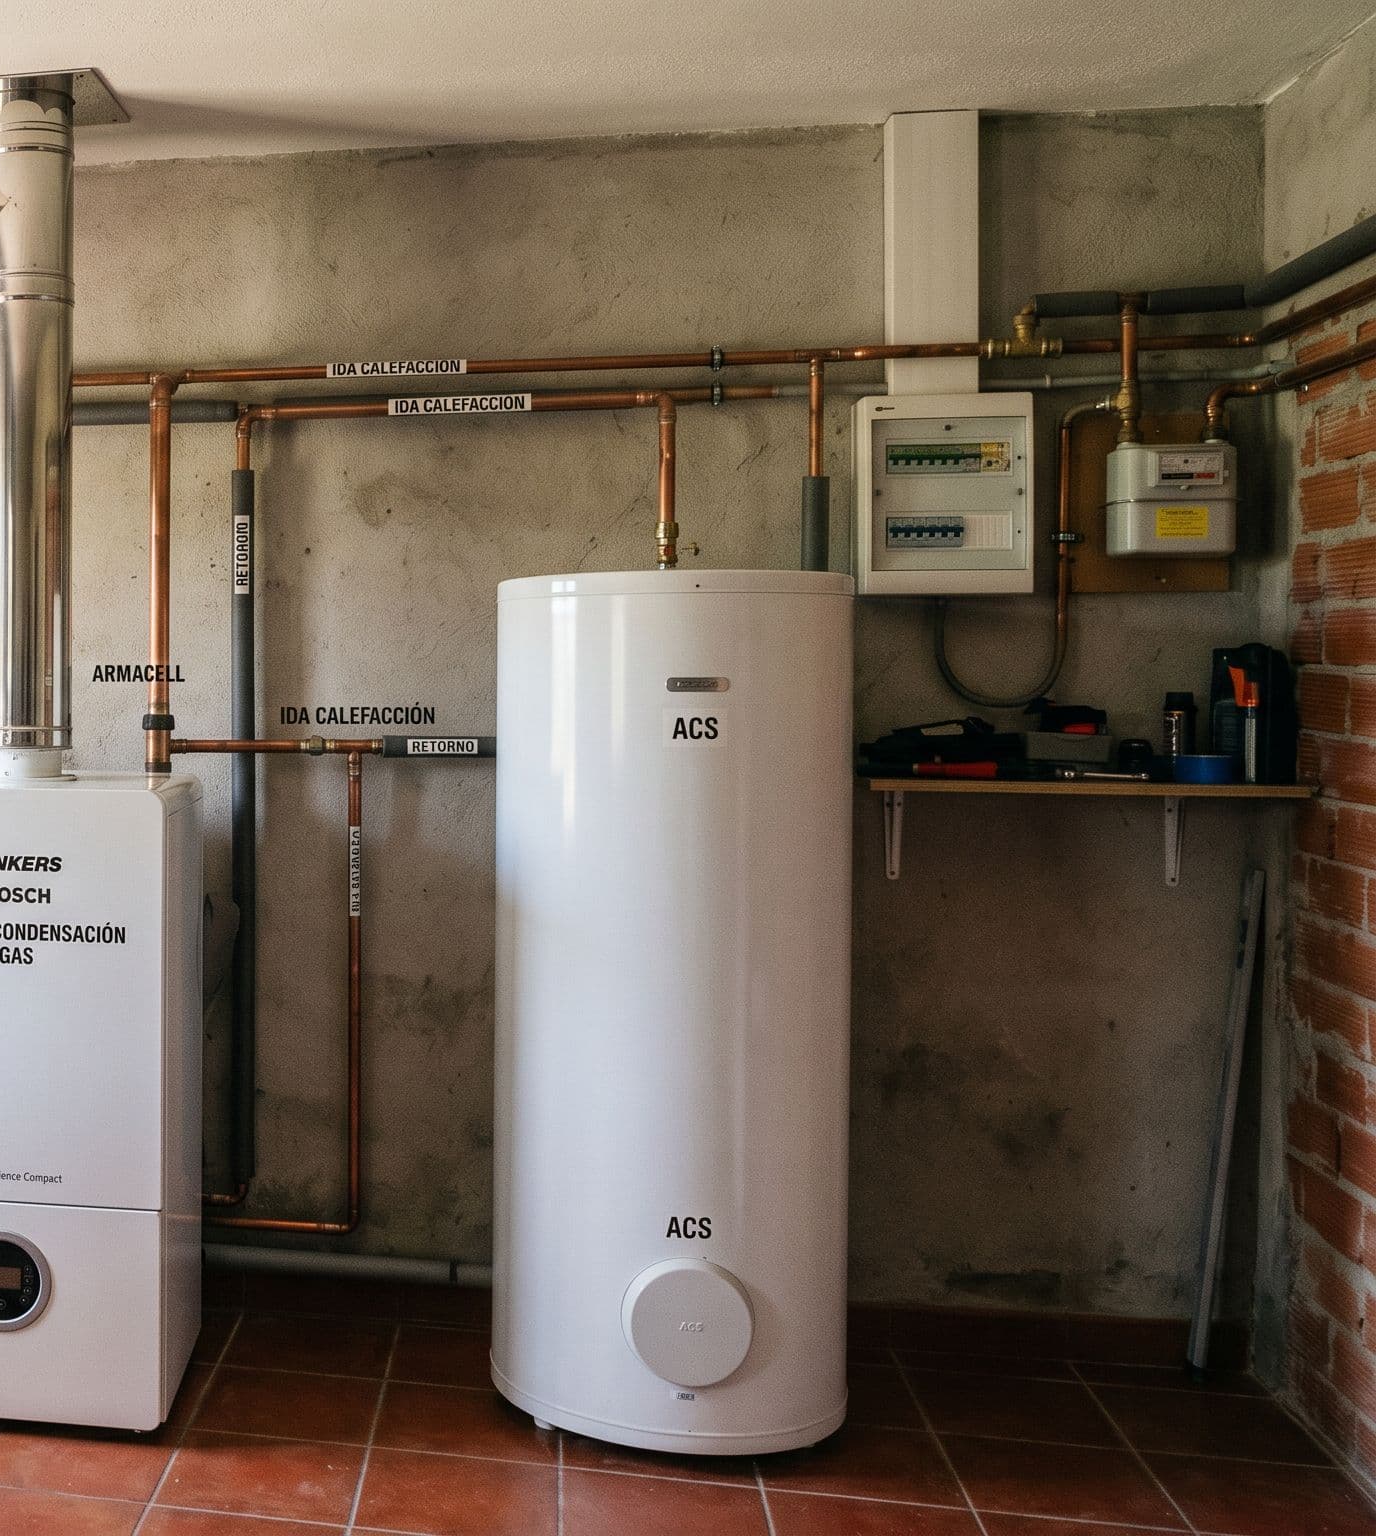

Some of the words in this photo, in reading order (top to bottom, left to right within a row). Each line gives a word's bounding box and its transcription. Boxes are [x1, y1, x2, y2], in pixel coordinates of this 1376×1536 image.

[332, 362, 356, 376] IDA
[395, 399, 419, 414] IDA
[673, 717, 718, 739] ACS
[413, 741, 474, 754] RETORNO
[0, 947, 33, 964] GAS
[24, 1172, 61, 1184] Compact
[667, 1217, 711, 1239] ACS
